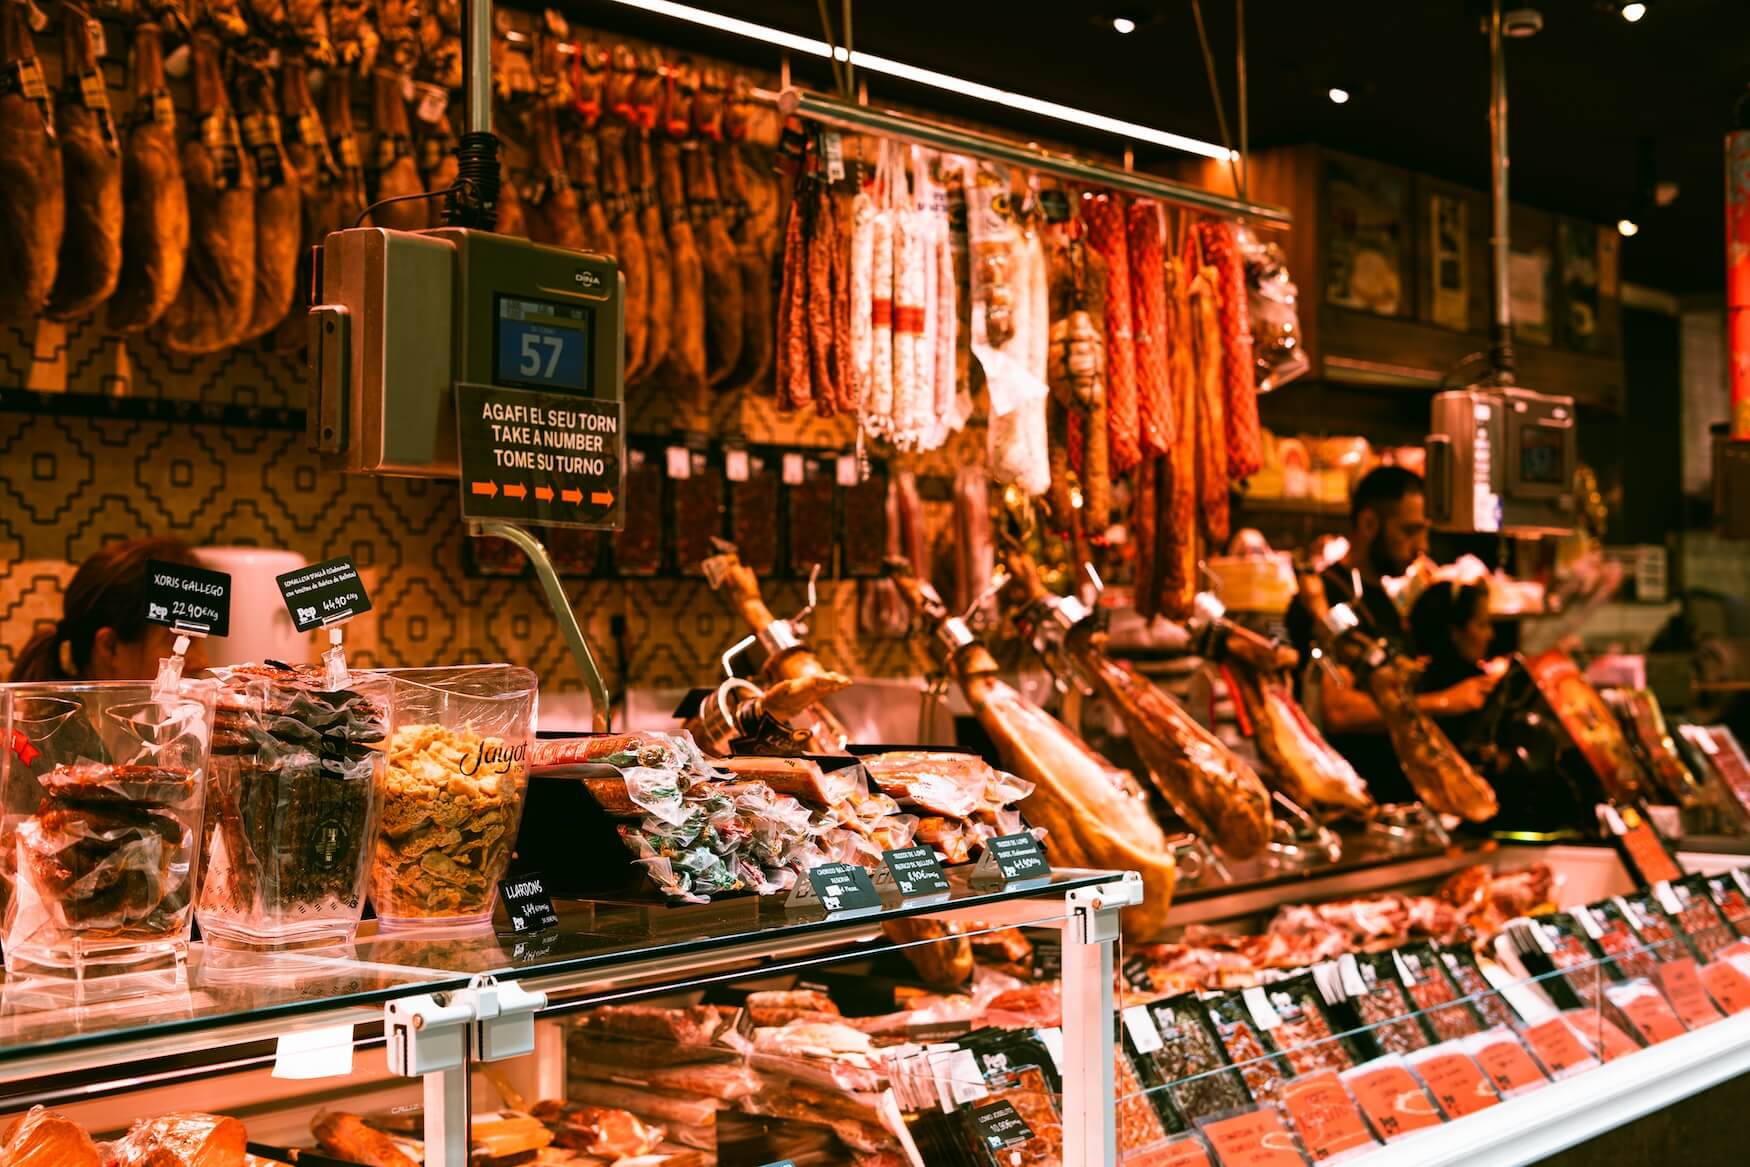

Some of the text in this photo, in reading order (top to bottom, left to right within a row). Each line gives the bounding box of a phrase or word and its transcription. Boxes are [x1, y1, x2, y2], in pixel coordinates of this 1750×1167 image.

[575, 272, 601, 287] DINA
[520, 333, 564, 378] 57
[482, 402, 617, 433] AGAFI EL SEU TORN
[491, 424, 603, 452] TAKE A NUMBER
[494, 449, 604, 476] TOME SU TURNO
[154, 574, 224, 597] XORIS GALLEGO
[505, 880, 543, 899] LLARDONS
